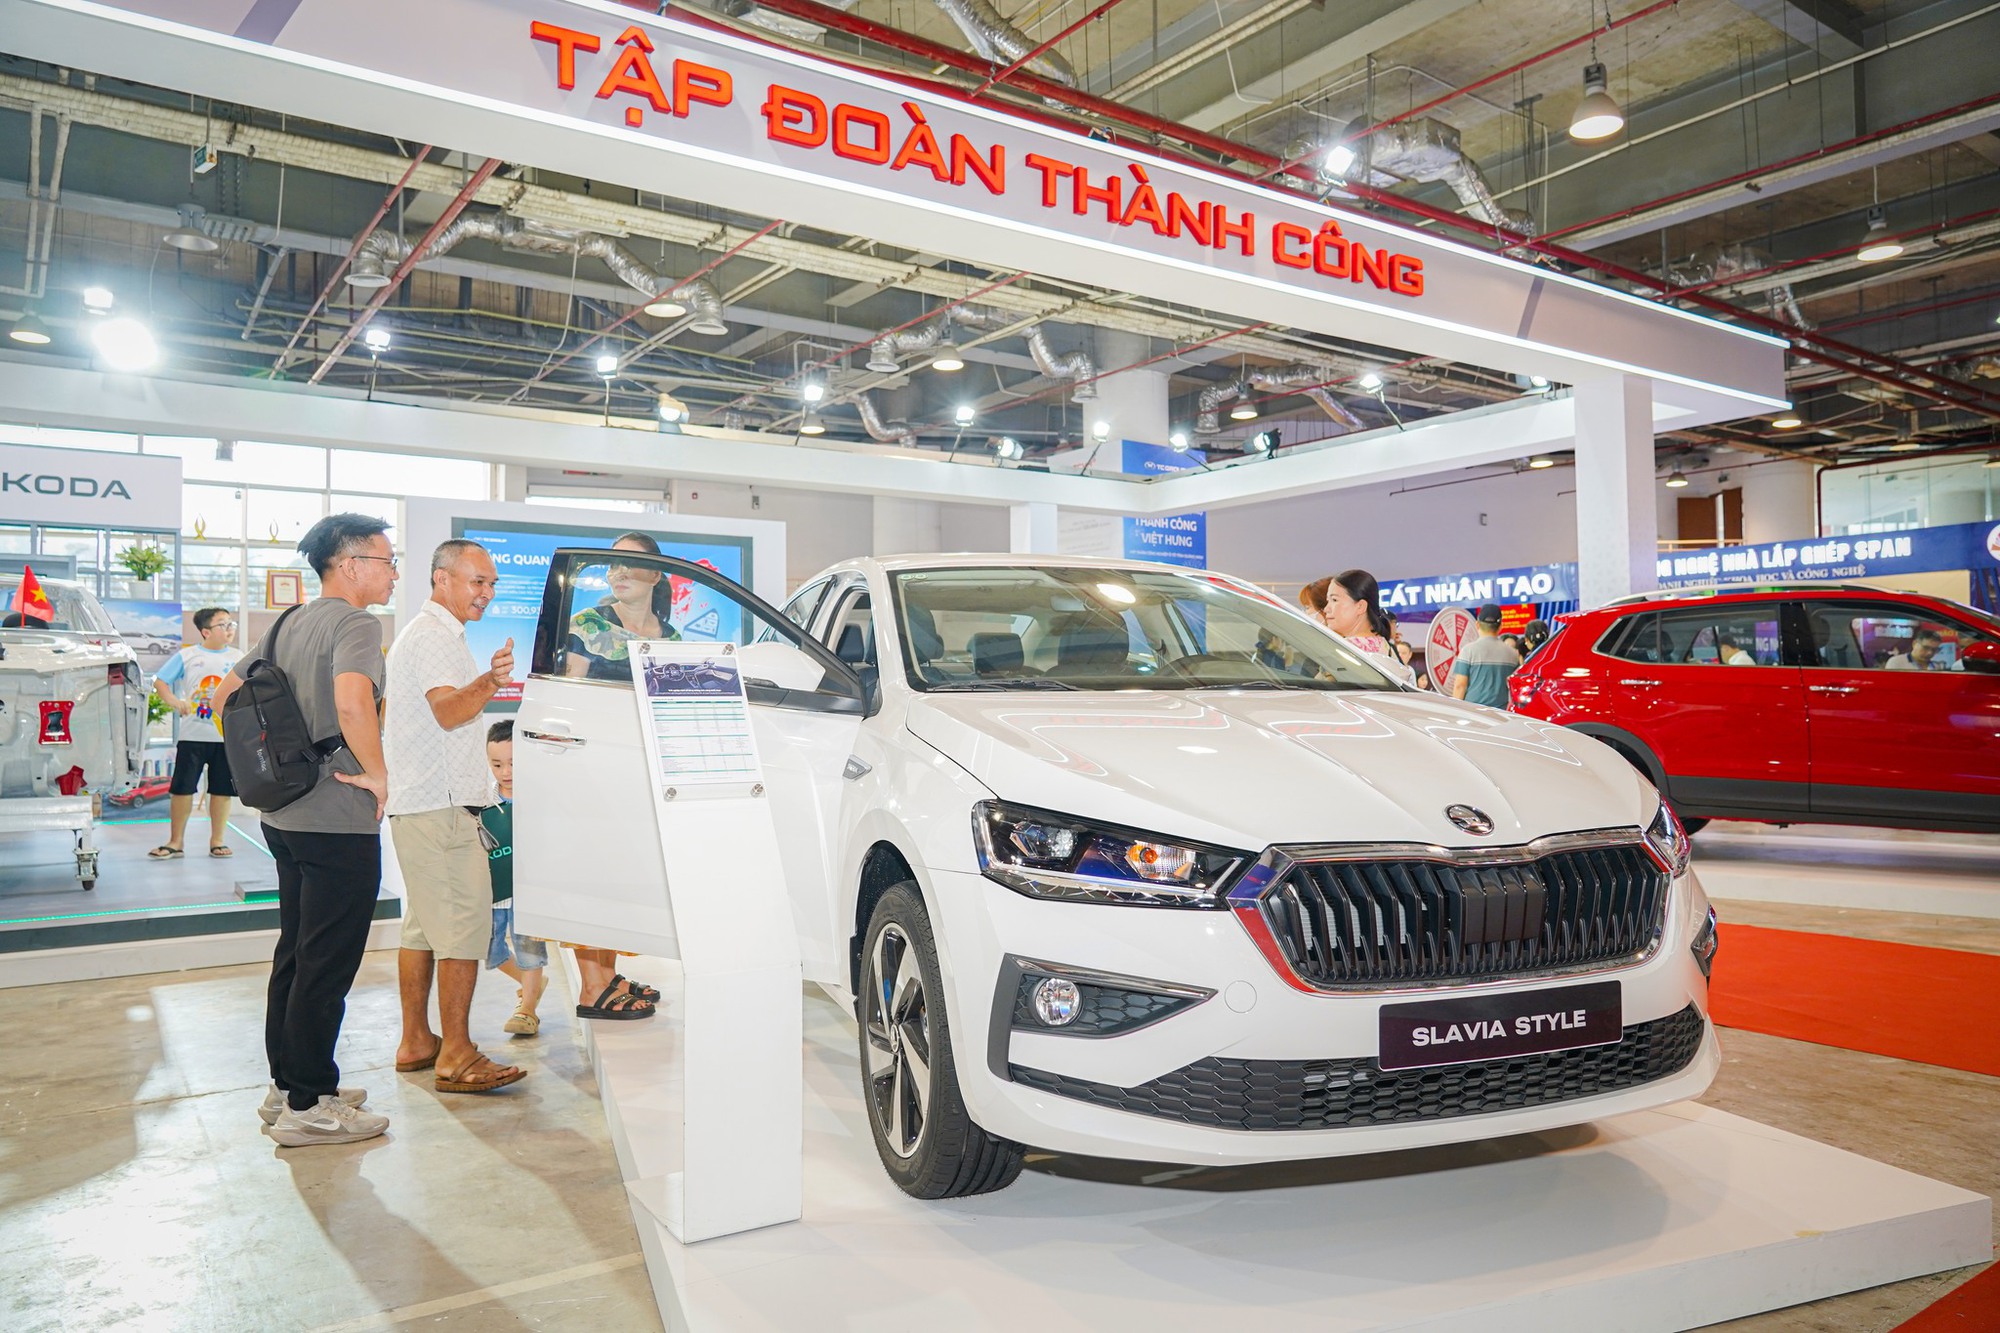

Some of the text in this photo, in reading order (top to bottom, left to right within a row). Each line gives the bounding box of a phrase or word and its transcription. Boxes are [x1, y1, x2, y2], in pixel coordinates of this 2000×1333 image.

[530, 20, 1425, 297] TẬP ĐOÀN THÀNH CÔNG
[1170, 517, 1197, 531] CÔNG
[1141, 531, 1163, 547] VIỆT
[513, 553, 550, 566] QUAN
[1674, 552, 1719, 576] NGHỆ
[1722, 548, 1759, 572] NHÀ
[1800, 541, 1850, 565] GHÉP
[1854, 537, 1911, 560] SPAN
[1796, 567, 1829, 580] CÔNG
[1832, 563, 1866, 577] NGHỆ
[1425, 577, 1492, 604] NHÂN
[1496, 573, 1554, 602] TẠO
[1412, 1009, 1587, 1047] SLAVIA STYLE
